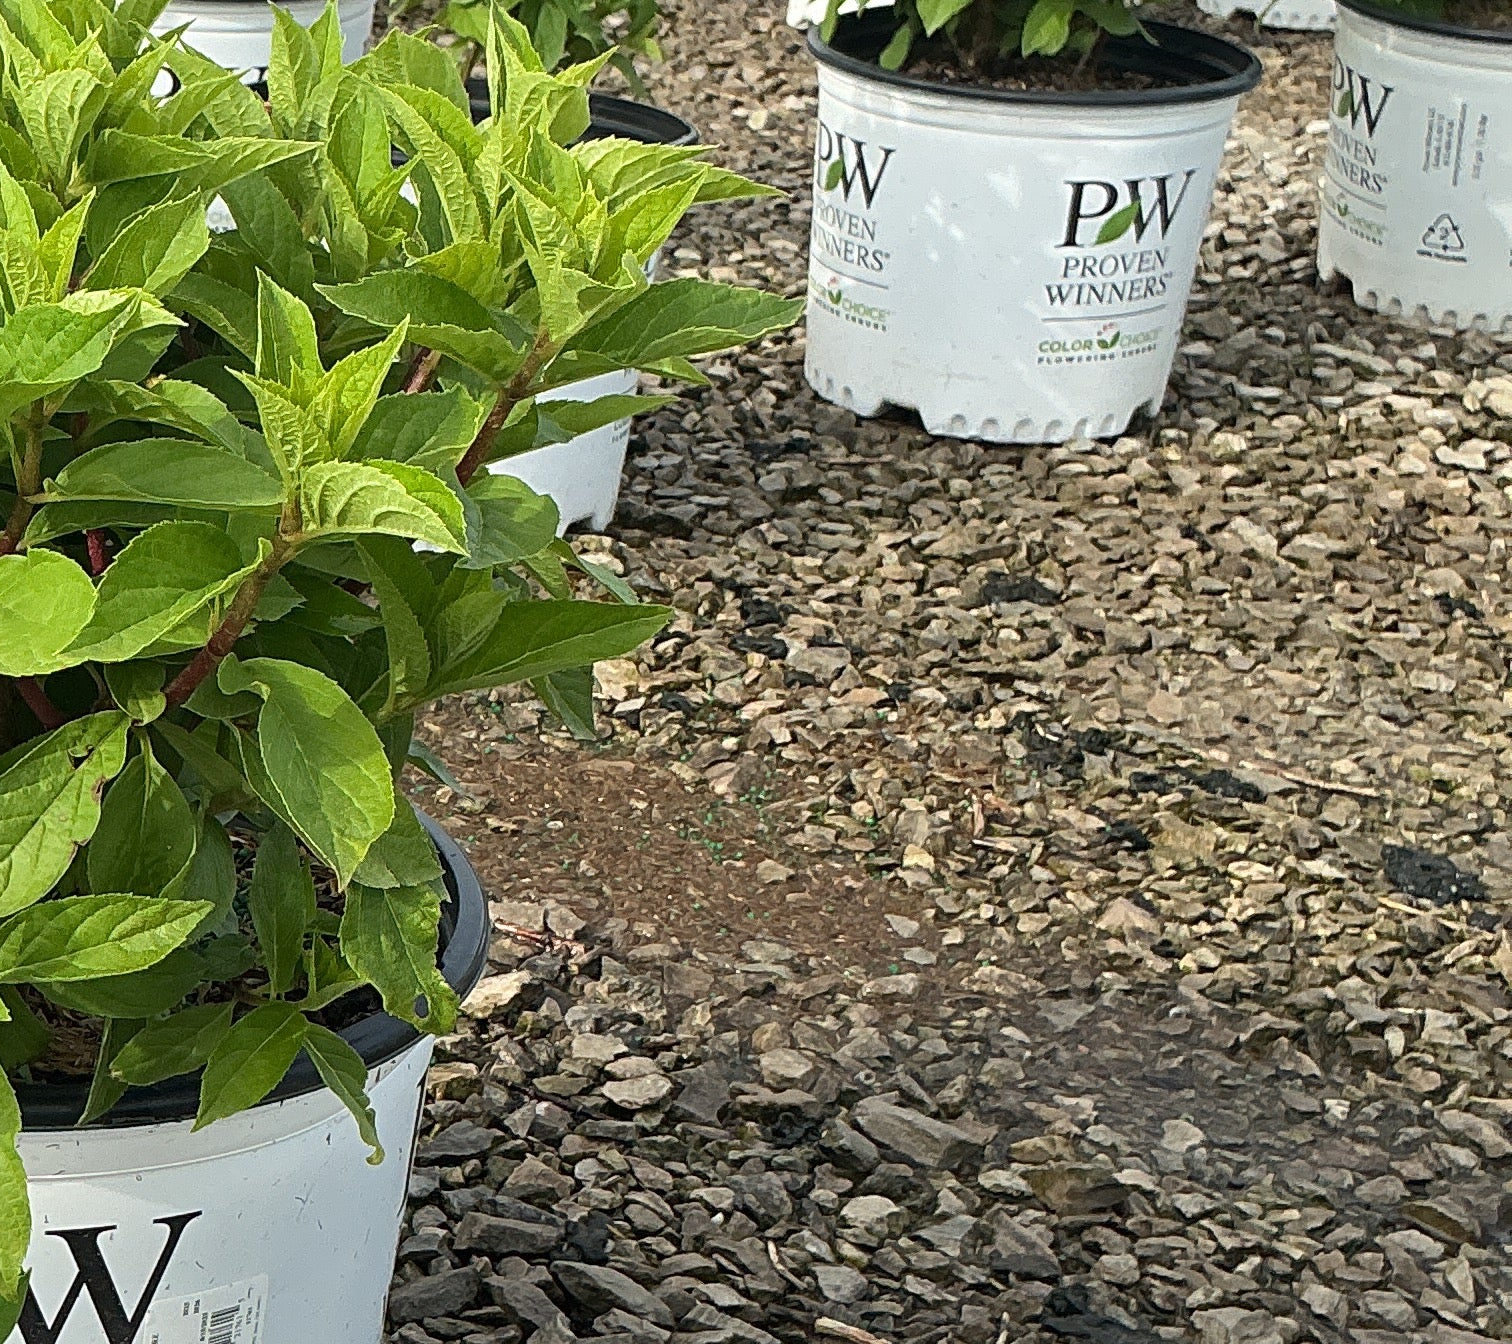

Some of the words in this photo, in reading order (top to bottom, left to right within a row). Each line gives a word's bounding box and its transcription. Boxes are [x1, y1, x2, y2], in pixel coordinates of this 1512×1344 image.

[1054, 166, 1201, 250] PW
[1061, 246, 1170, 279] PROVEN
[1038, 338, 1094, 354] COLOR
